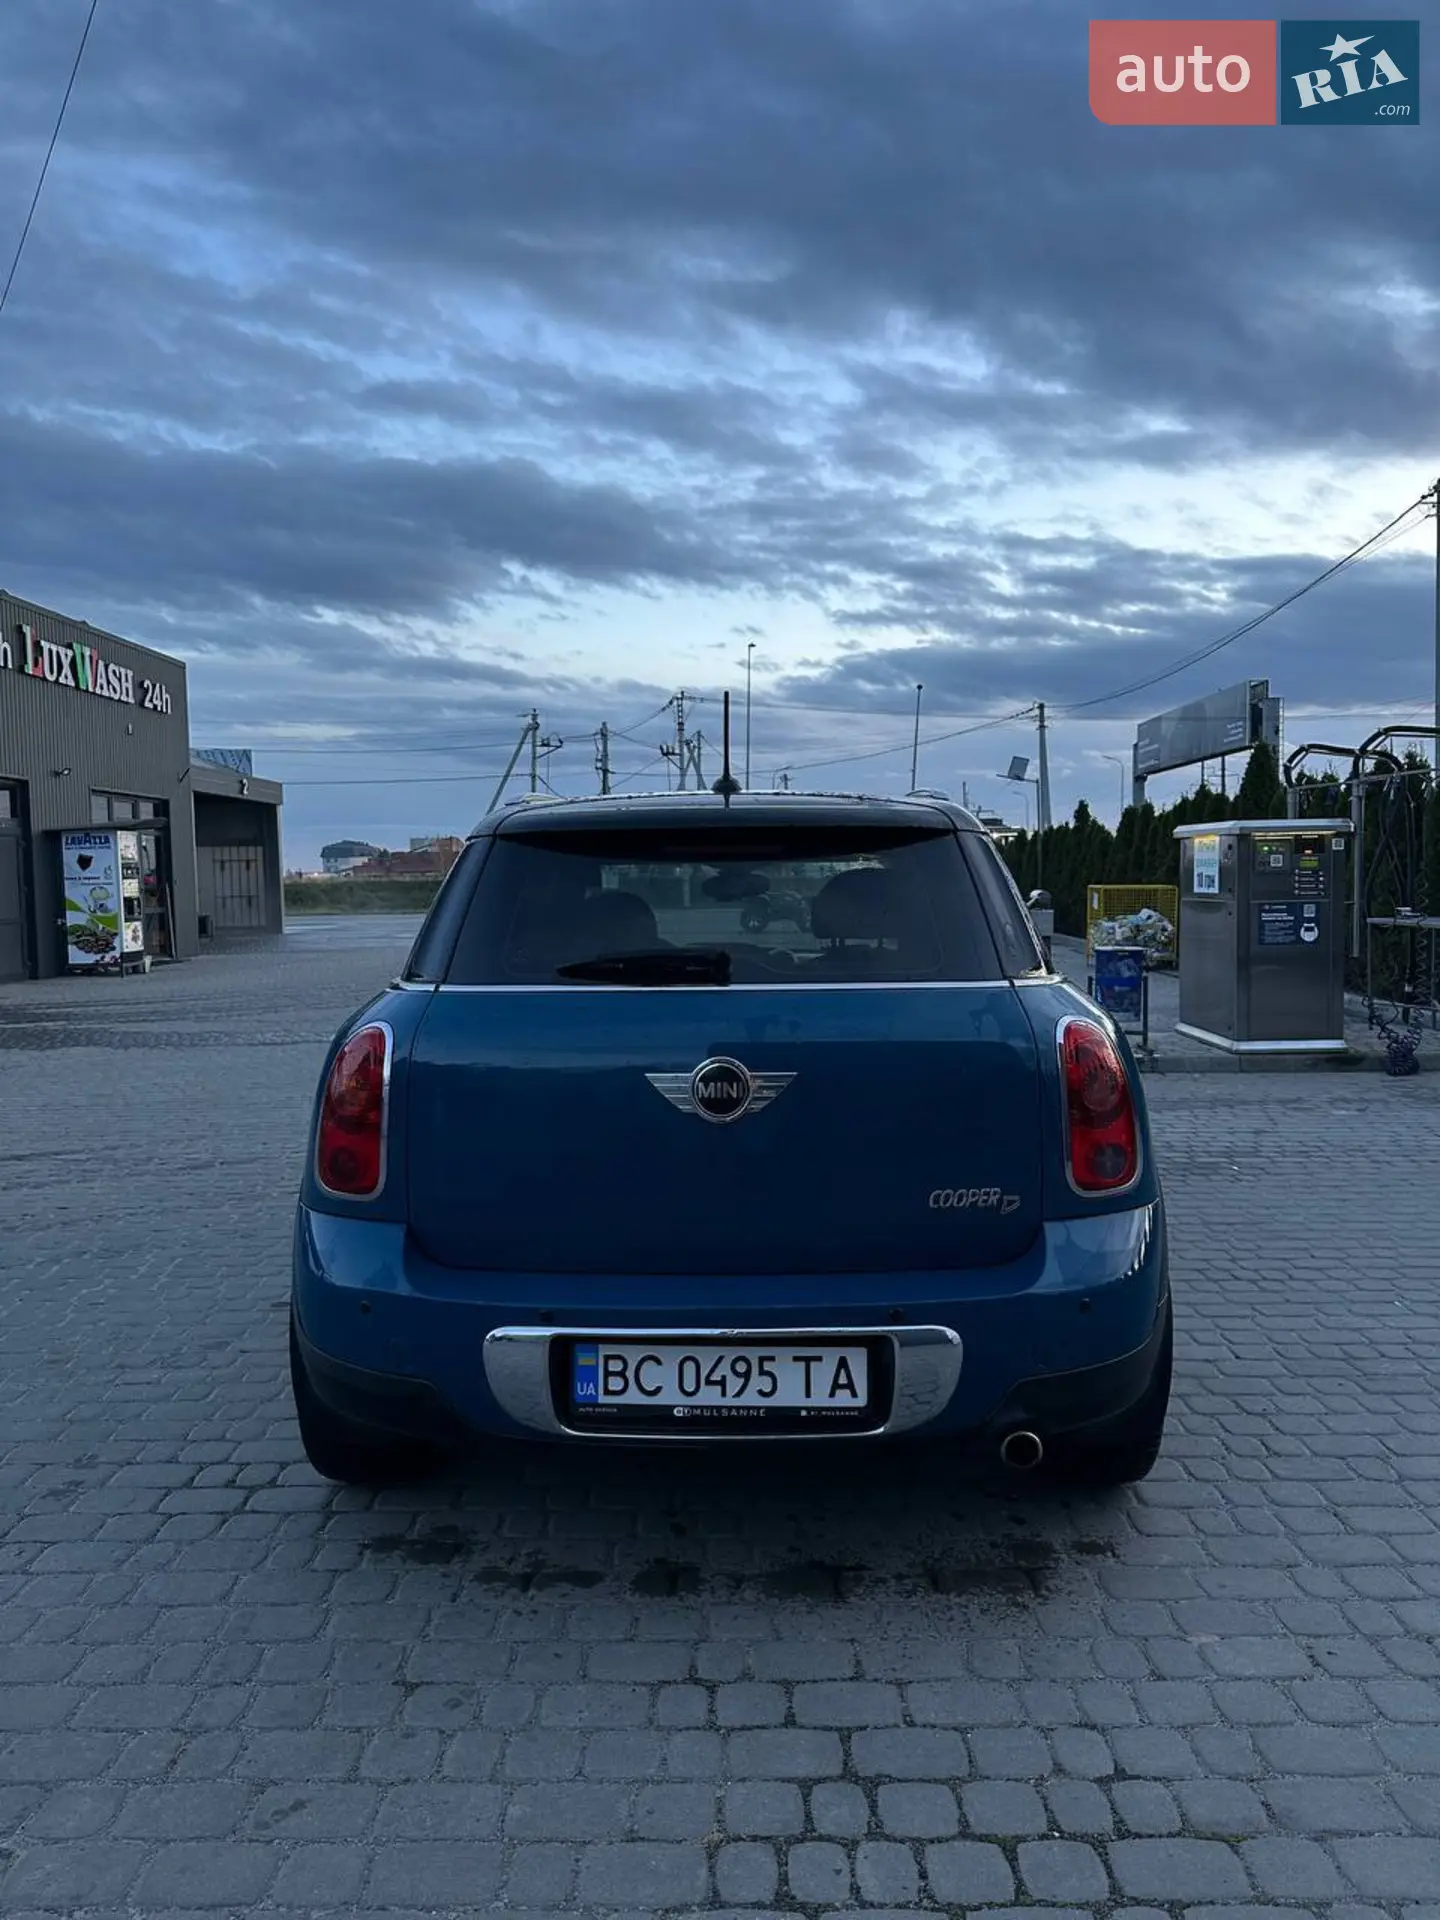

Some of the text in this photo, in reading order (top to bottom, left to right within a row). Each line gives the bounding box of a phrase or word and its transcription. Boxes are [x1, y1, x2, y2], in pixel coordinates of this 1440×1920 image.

[143, 679, 172, 714] 24h
[65, 833, 110, 846] LAVAZZA
[698, 1082, 743, 1099] MINI
[929, 1188, 1001, 1208] COOPER
[603, 1354, 859, 1398] BC 0495 TA
[577, 1382, 596, 1396] UA
